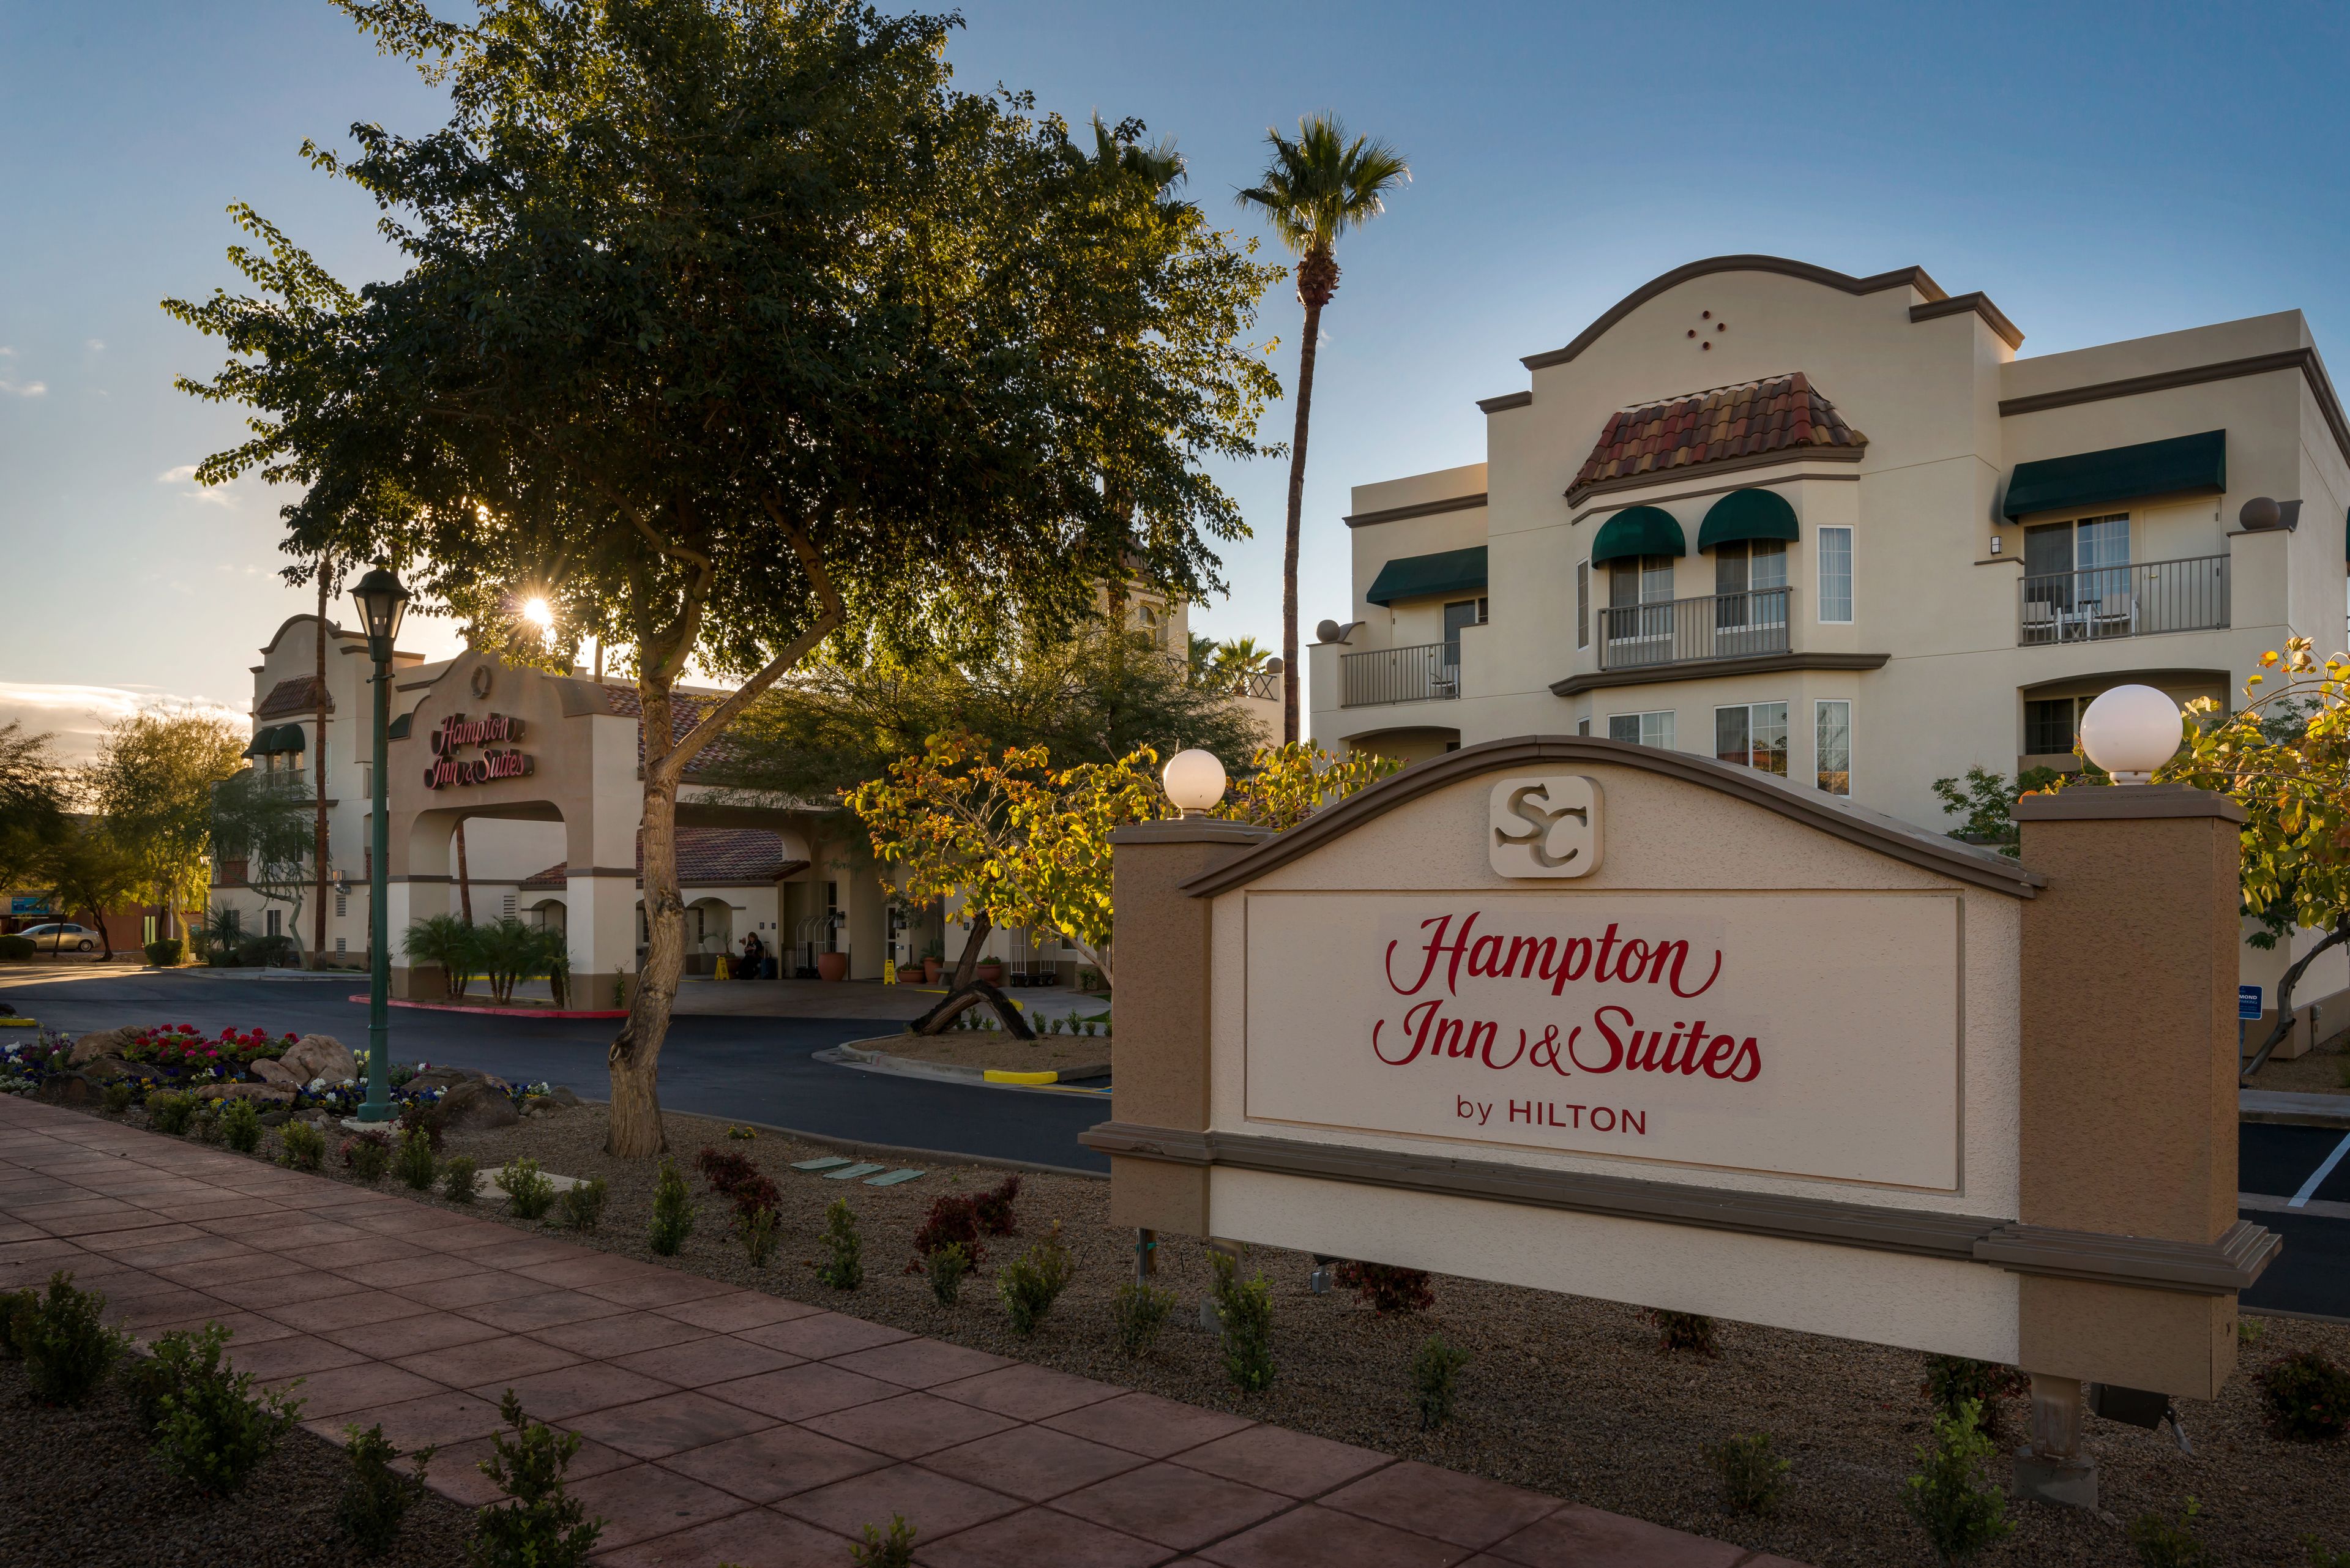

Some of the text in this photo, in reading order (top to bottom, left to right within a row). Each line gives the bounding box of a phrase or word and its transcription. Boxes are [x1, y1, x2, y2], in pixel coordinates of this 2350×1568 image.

[430, 713, 519, 756] Hampton
[423, 749, 524, 790] Inn & Suites
[1385, 911, 1722, 998] Hampton
[1373, 999, 1762, 1083] Inn & Suites
[1456, 1094, 1647, 1135] by HILTON
